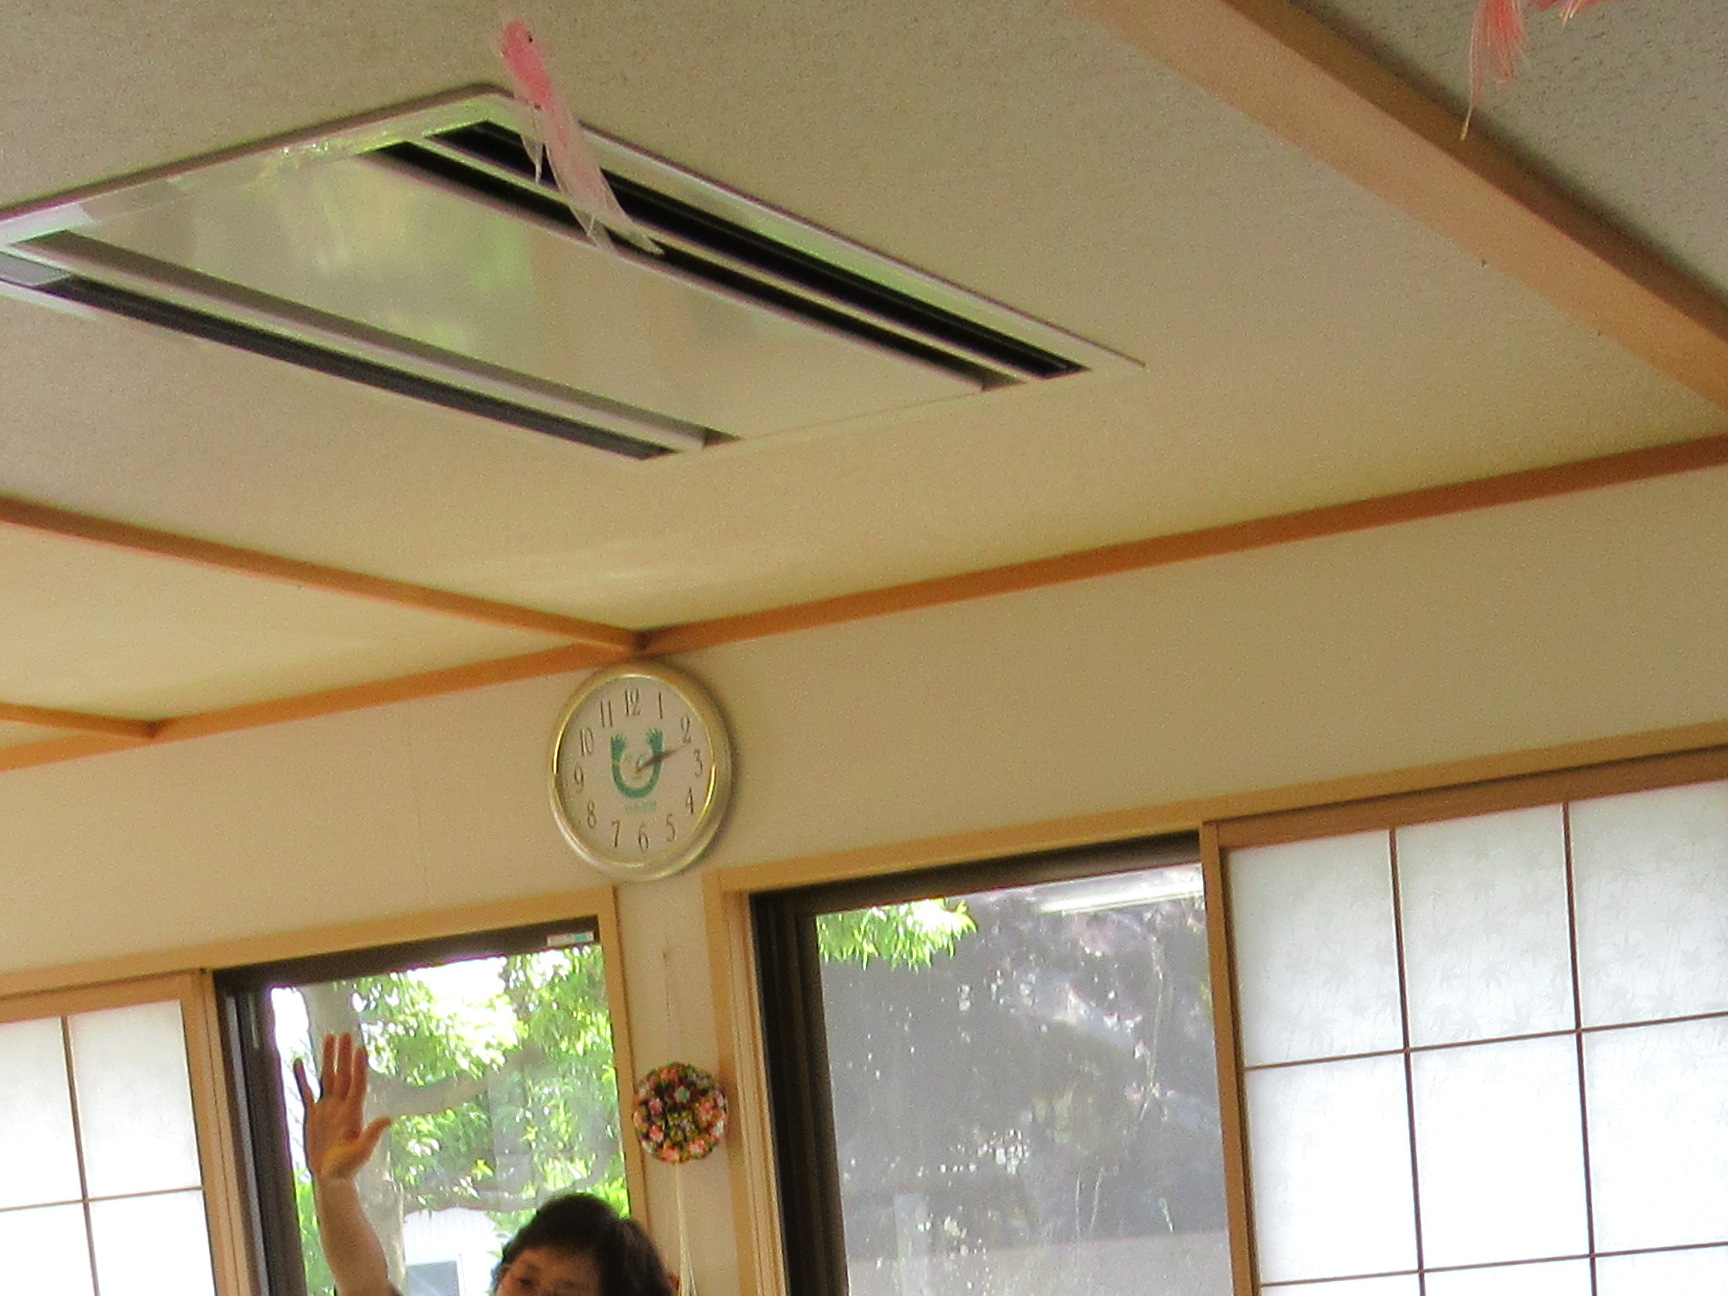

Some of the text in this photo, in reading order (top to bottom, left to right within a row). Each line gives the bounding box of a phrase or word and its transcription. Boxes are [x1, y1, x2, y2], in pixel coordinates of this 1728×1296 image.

[600, 700, 613, 728] 11
[624, 688, 641, 717] 12
[657, 692, 663, 719] 1
[580, 728, 594, 757] 10
[680, 715, 692, 745] 2
[694, 749, 703, 778] 3
[574, 765, 584, 794] 9
[587, 801, 597, 829] 8
[685, 787, 694, 815] 4
[612, 820, 621, 848] 7
[638, 824, 649, 852] 6
[666, 814, 676, 842] 5
